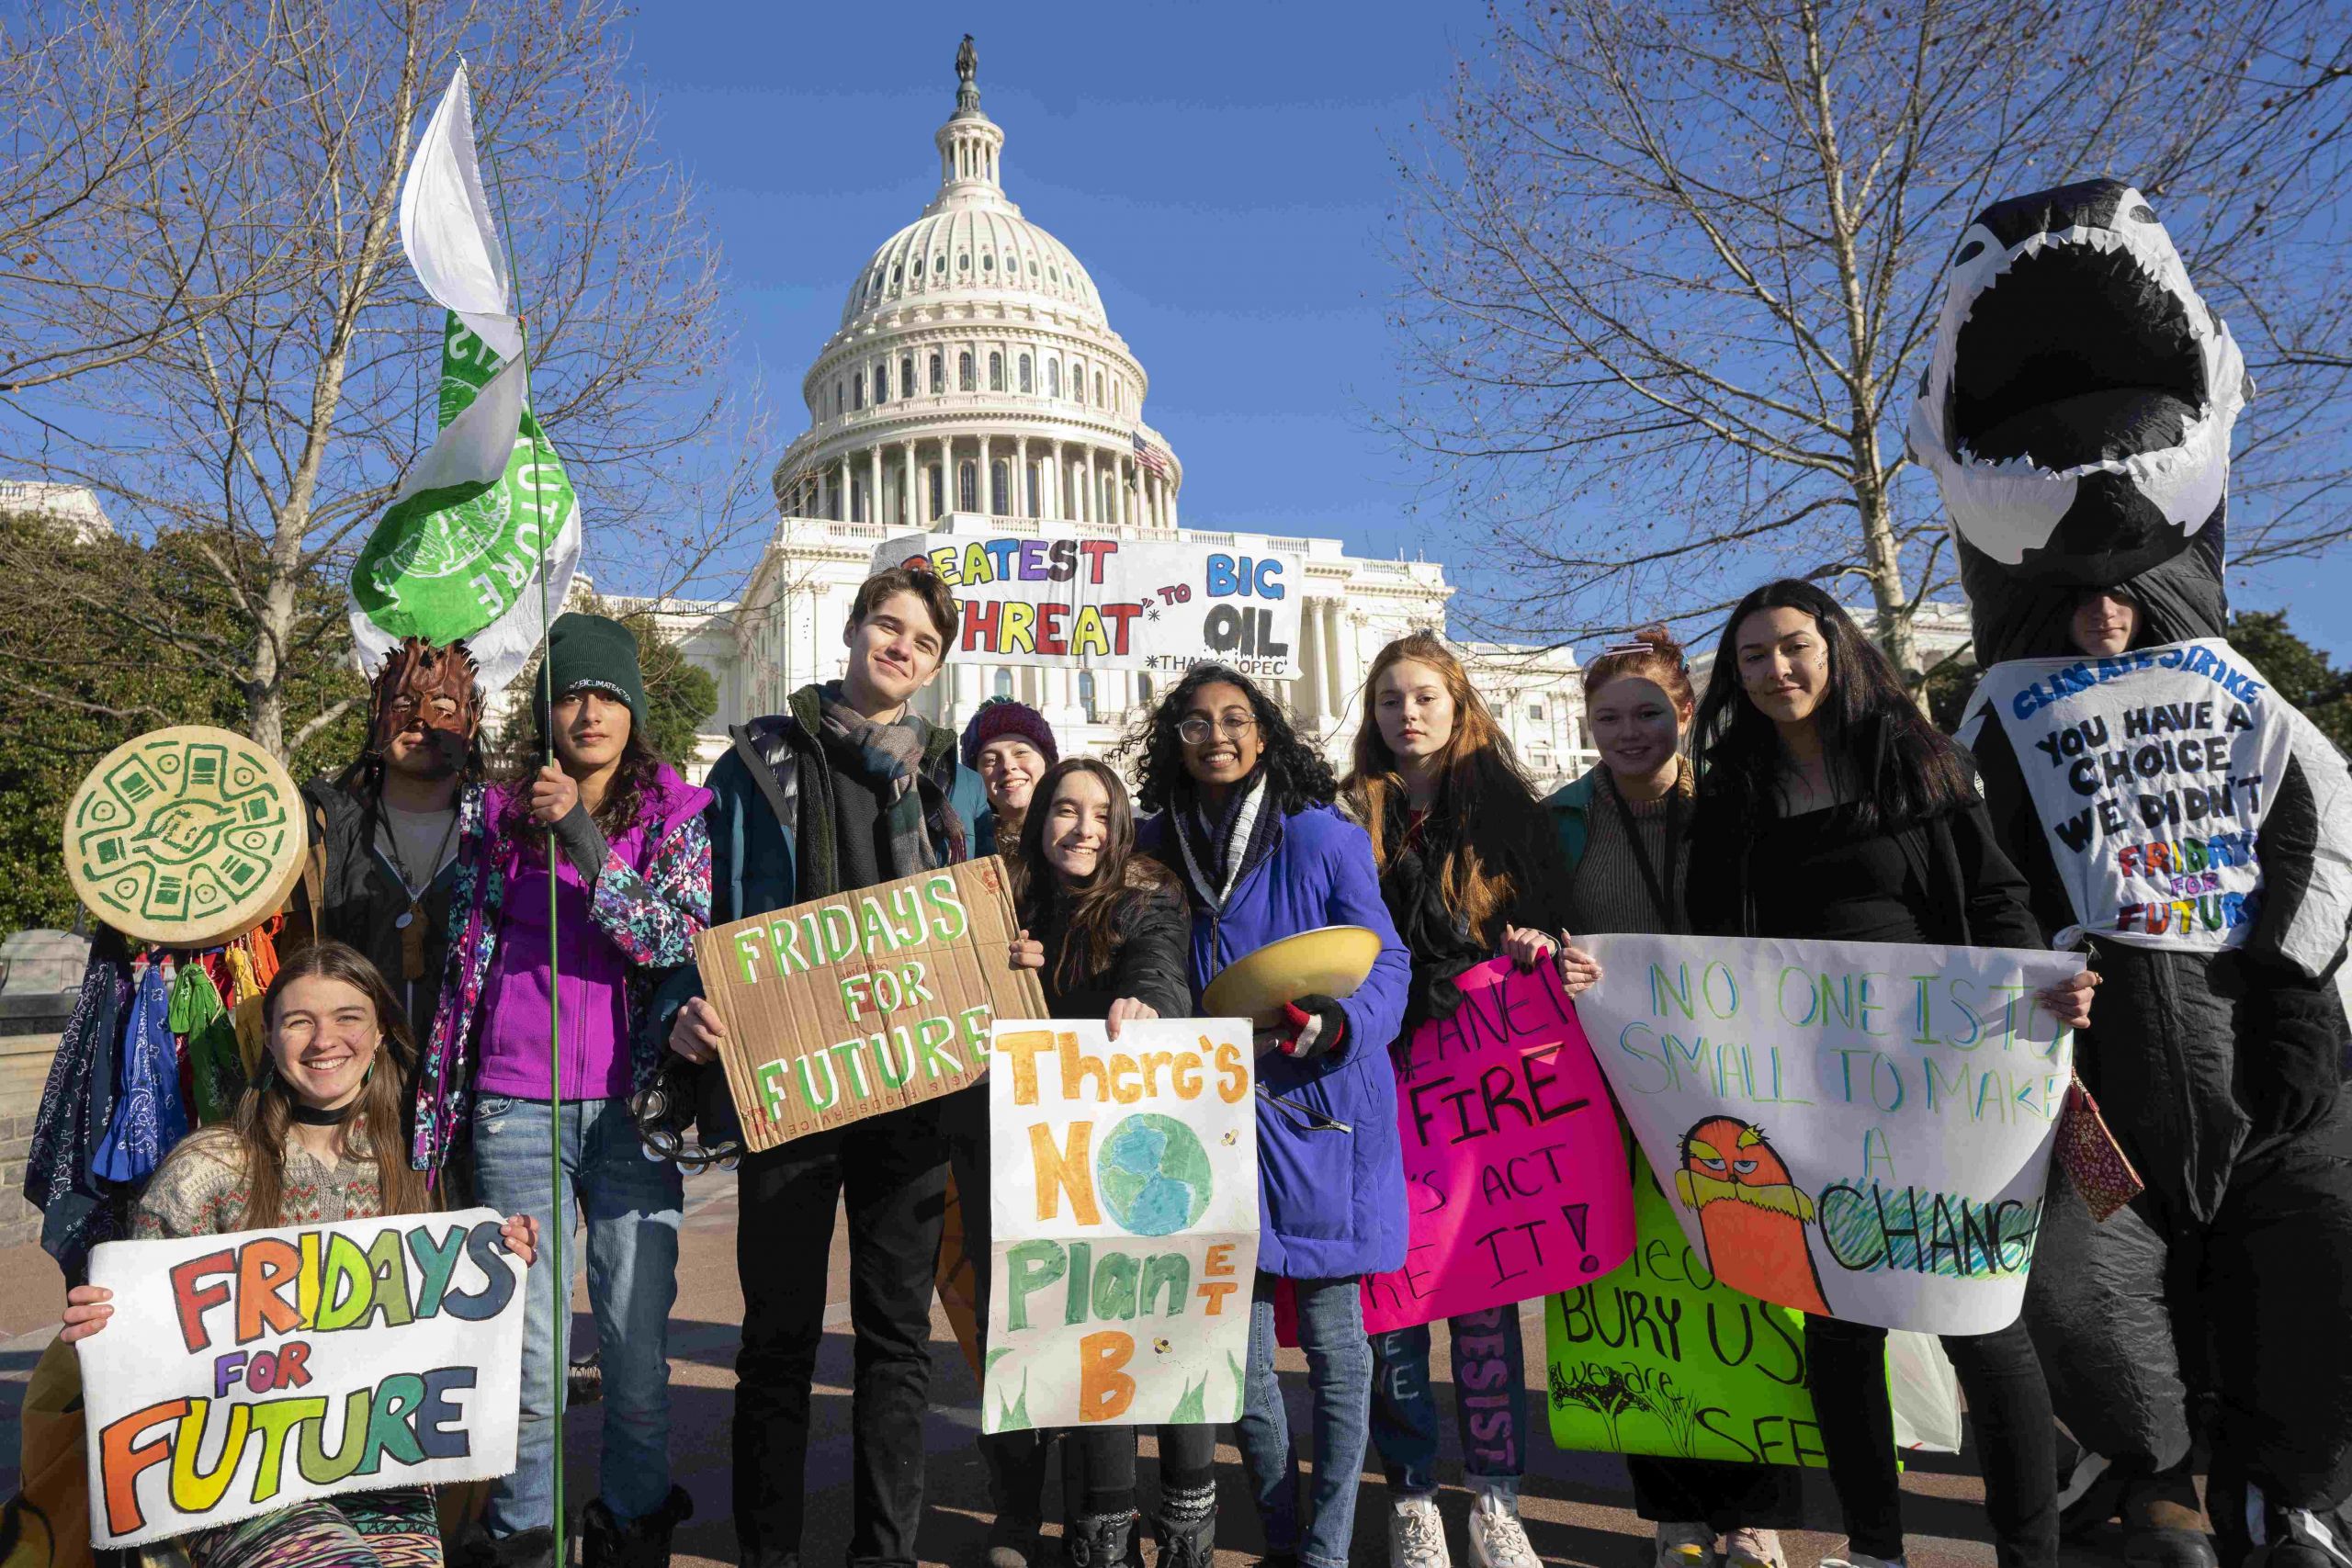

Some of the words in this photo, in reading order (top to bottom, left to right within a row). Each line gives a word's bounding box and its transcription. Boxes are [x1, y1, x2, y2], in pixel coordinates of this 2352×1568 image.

[910, 538, 1119, 586] EATEST
[1205, 553, 1285, 601] BIG
[1157, 582, 1192, 607] TO
[1203, 603, 1289, 659] OIL
[1239, 660, 1284, 675] OPEC
[2035, 716, 2109, 768] YOU
[2123, 701, 2212, 739] HAVE
[2224, 703, 2254, 733] A
[2069, 736, 2232, 796] CHOICE
[2054, 797, 2128, 853] WE
[2138, 775, 2263, 829] DIDN'T
[2118, 829, 2259, 877] FRIDAY
[2117, 892, 2253, 935] FUTUR
[2170, 872, 2220, 896] FOR
[735, 874, 968, 985] FRIDAYS
[840, 962, 933, 1022] FOR
[1651, 960, 1740, 1021] NO
[1778, 966, 1891, 1037] ONE
[1910, 975, 1986, 1052] IS
[757, 1004, 991, 1122] FUTURE
[995, 1030, 1250, 1106] There's
[1620, 1021, 1814, 1107] SMALL
[1831, 1046, 1905, 1112] TO
[1923, 1056, 2065, 1124] MAKE
[1408, 1042, 1589, 1147] FIRE
[1482, 1144, 1566, 1205] ACT
[1865, 1127, 1895, 1179] A
[169, 1221, 517, 1354] FRIDAYS
[1559, 1282, 1681, 1363] BURY
[1706, 1299, 1806, 1386] US
[214, 1341, 313, 1399] FOR
[1078, 1330, 1136, 1423] B
[99, 1366, 478, 1538] FUTURE
